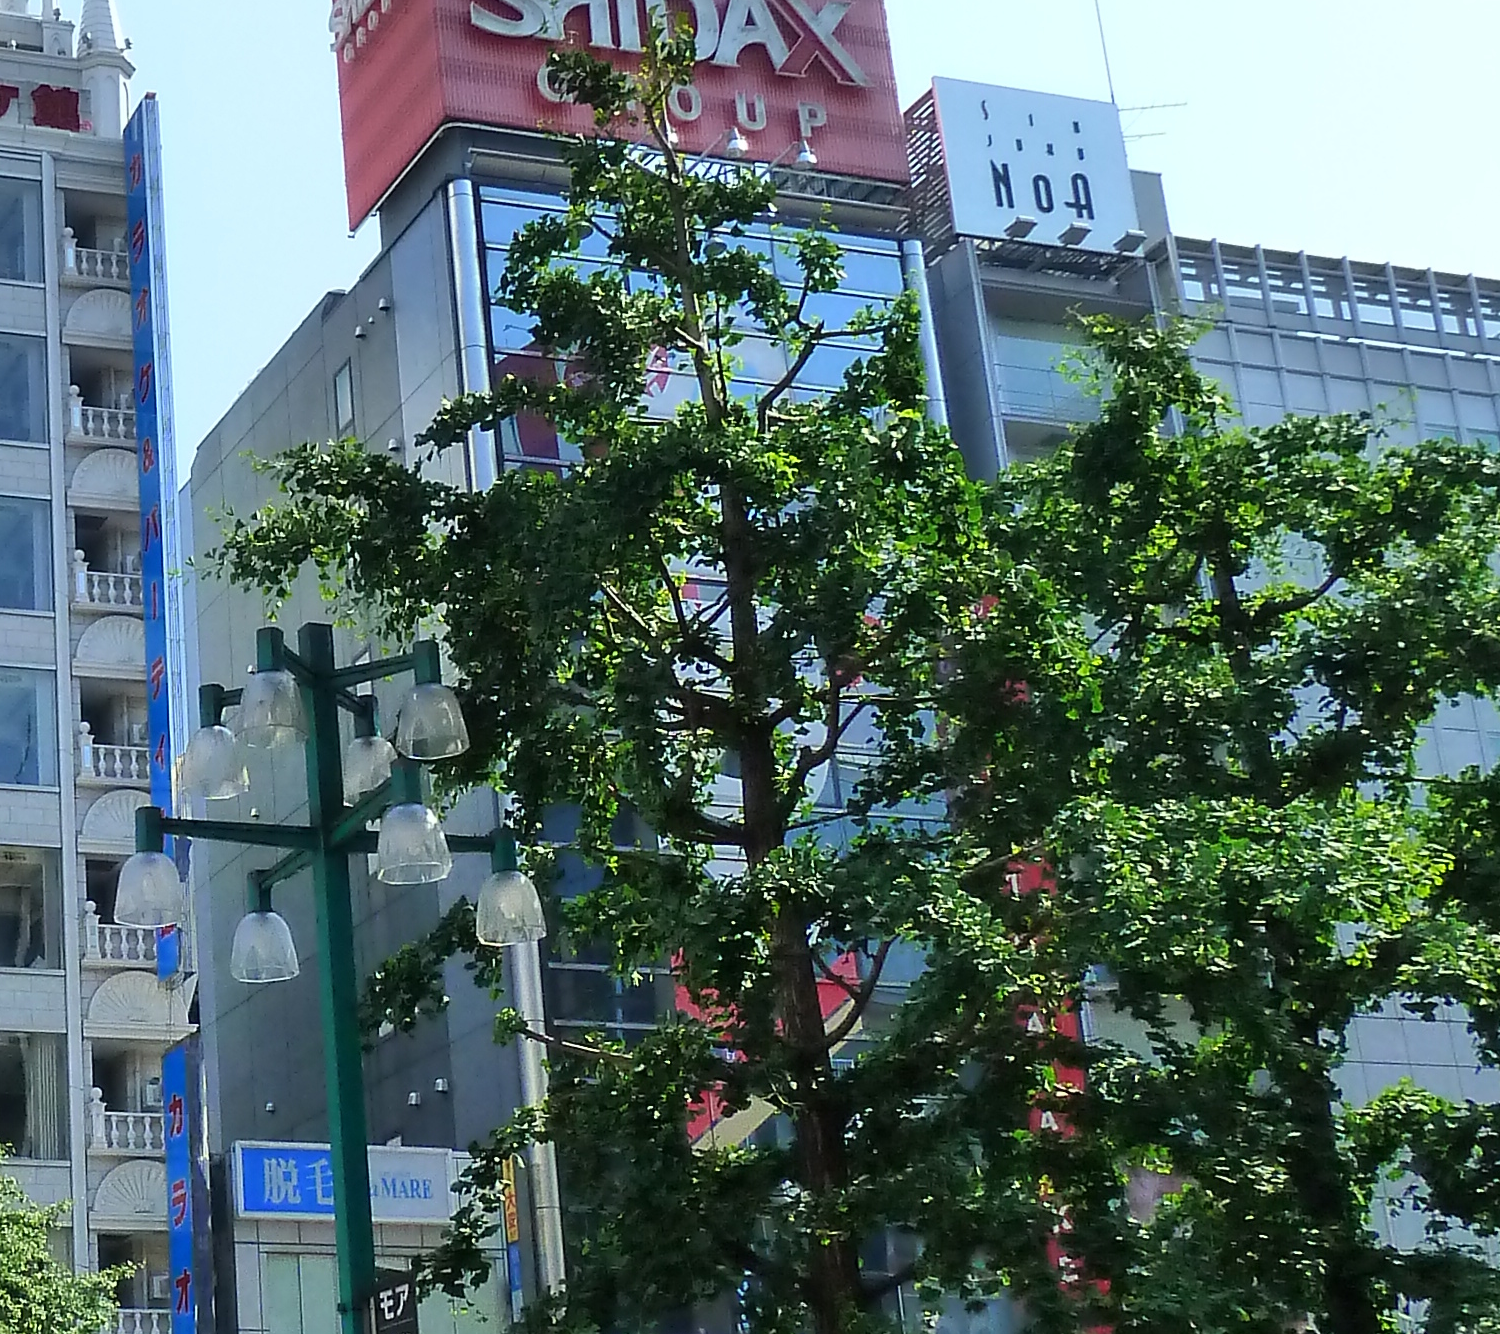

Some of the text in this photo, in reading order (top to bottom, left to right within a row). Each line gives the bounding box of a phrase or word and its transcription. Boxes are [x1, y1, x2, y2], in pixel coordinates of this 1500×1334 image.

[536, 62, 830, 139] GOUP
[988, 157, 1096, 221] NOA
[263, 1157, 334, 1205] 脱毛
[378, 1283, 410, 1321] モア
